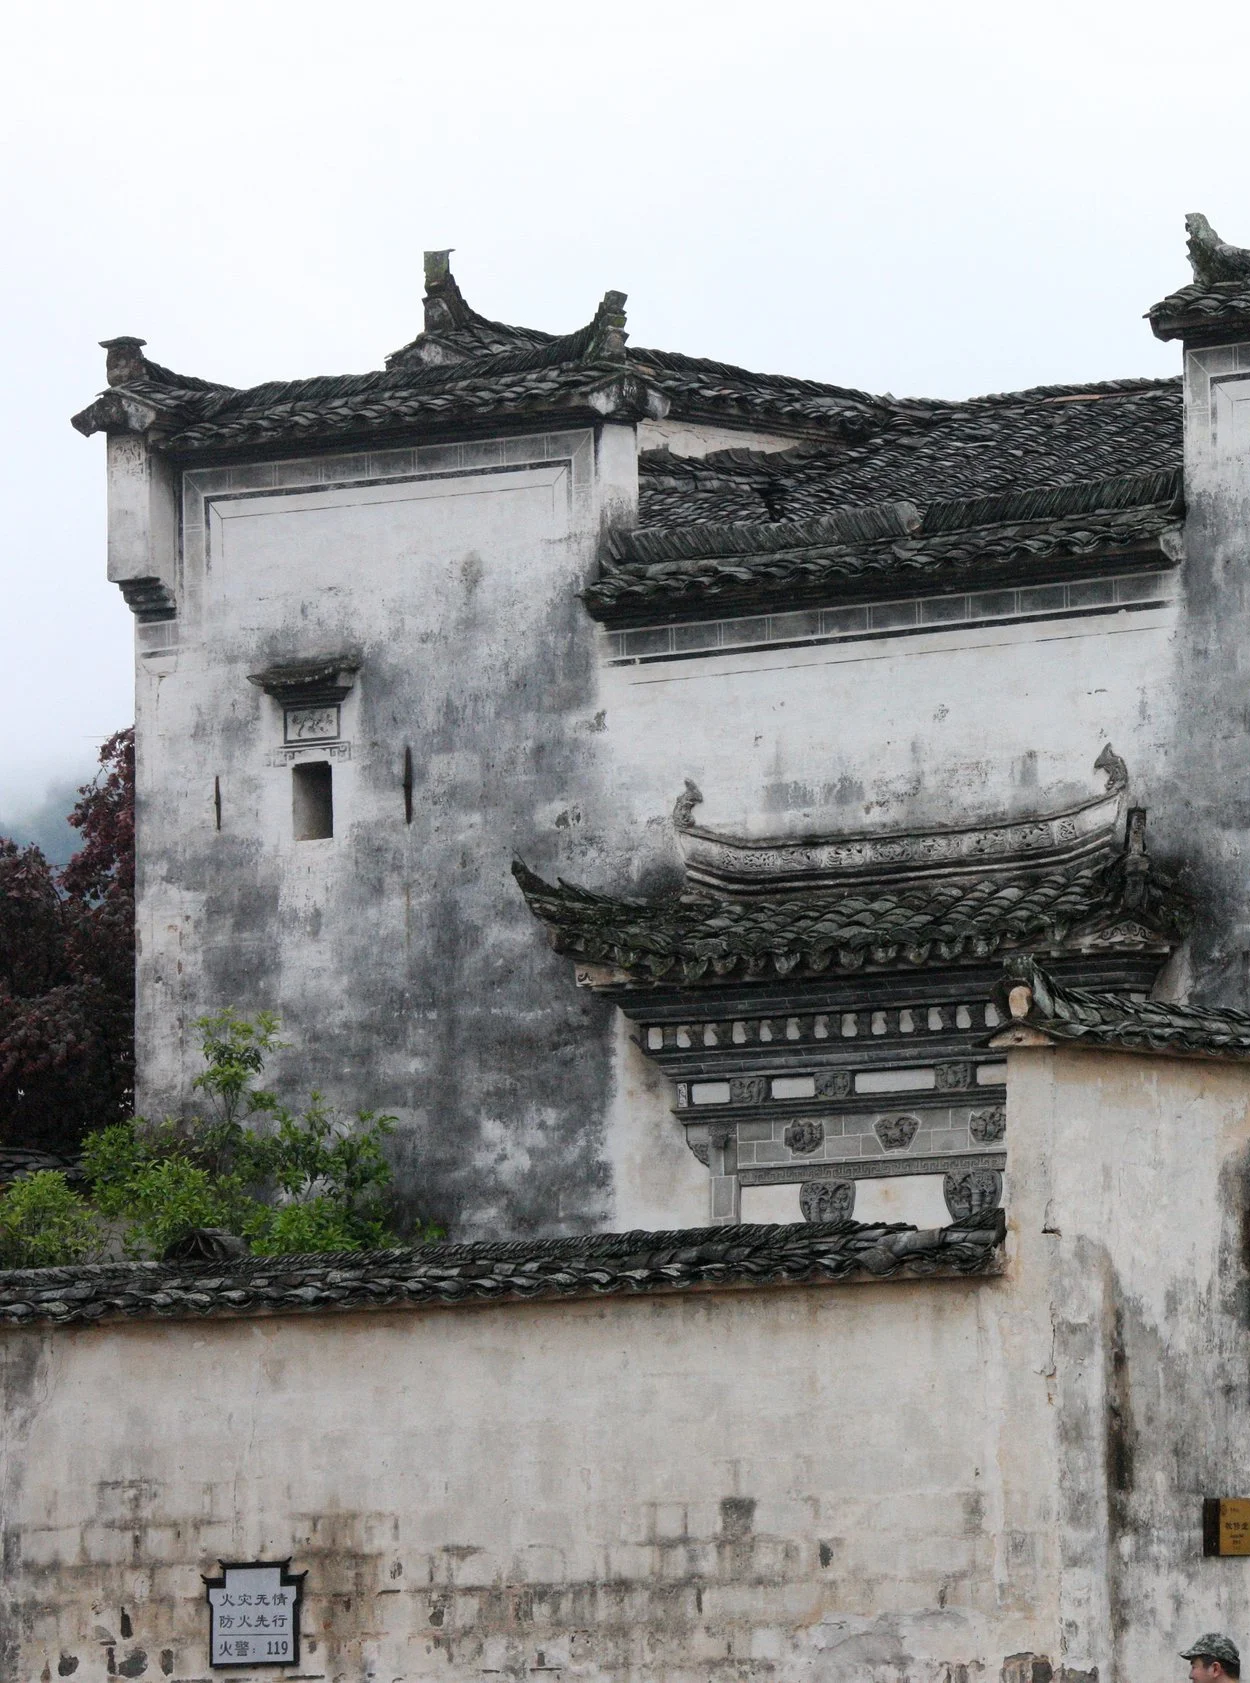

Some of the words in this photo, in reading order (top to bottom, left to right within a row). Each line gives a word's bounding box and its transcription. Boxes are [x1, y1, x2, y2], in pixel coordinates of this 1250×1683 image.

[219, 1593, 288, 1606] 火灾无情
[219, 1614, 288, 1629] 防火先行
[266, 1641, 289, 1655] 119
